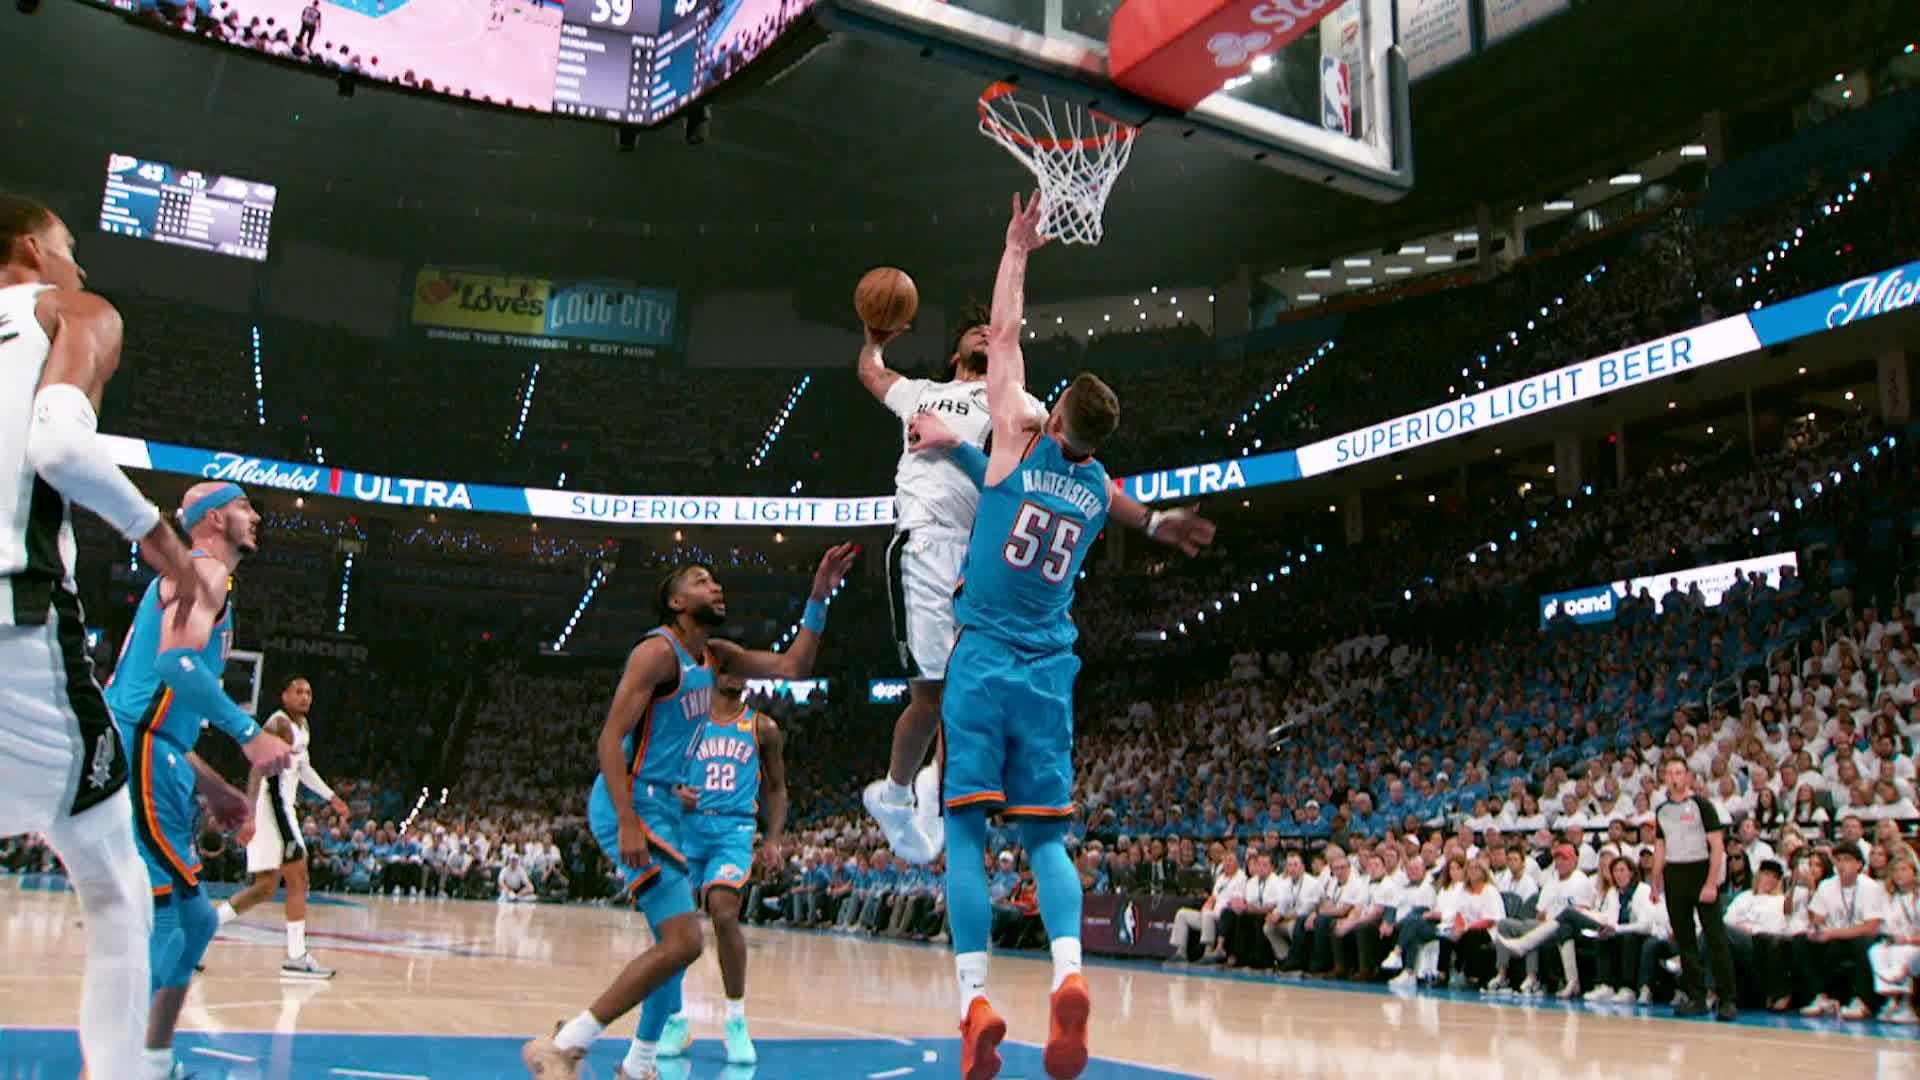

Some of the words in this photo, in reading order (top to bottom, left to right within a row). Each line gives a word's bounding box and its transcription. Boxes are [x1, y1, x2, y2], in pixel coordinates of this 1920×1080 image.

[472, 332, 501, 345] THE
[504, 335, 568, 351] THUNDER
[1336, 402, 1475, 463] SUPERIOR
[1490, 368, 1582, 419] LIGHT
[1599, 336, 1693, 388] BEER
[202, 452, 318, 492] Michelob
[354, 475, 472, 510] ULTRA
[1135, 461, 1246, 503] ULTRA
[570, 496, 721, 520] SUPERIOR
[734, 501, 822, 522] LIGHT
[834, 500, 897, 522] BEE
[1003, 500, 1083, 585] 55
[704, 761, 736, 792] 22
